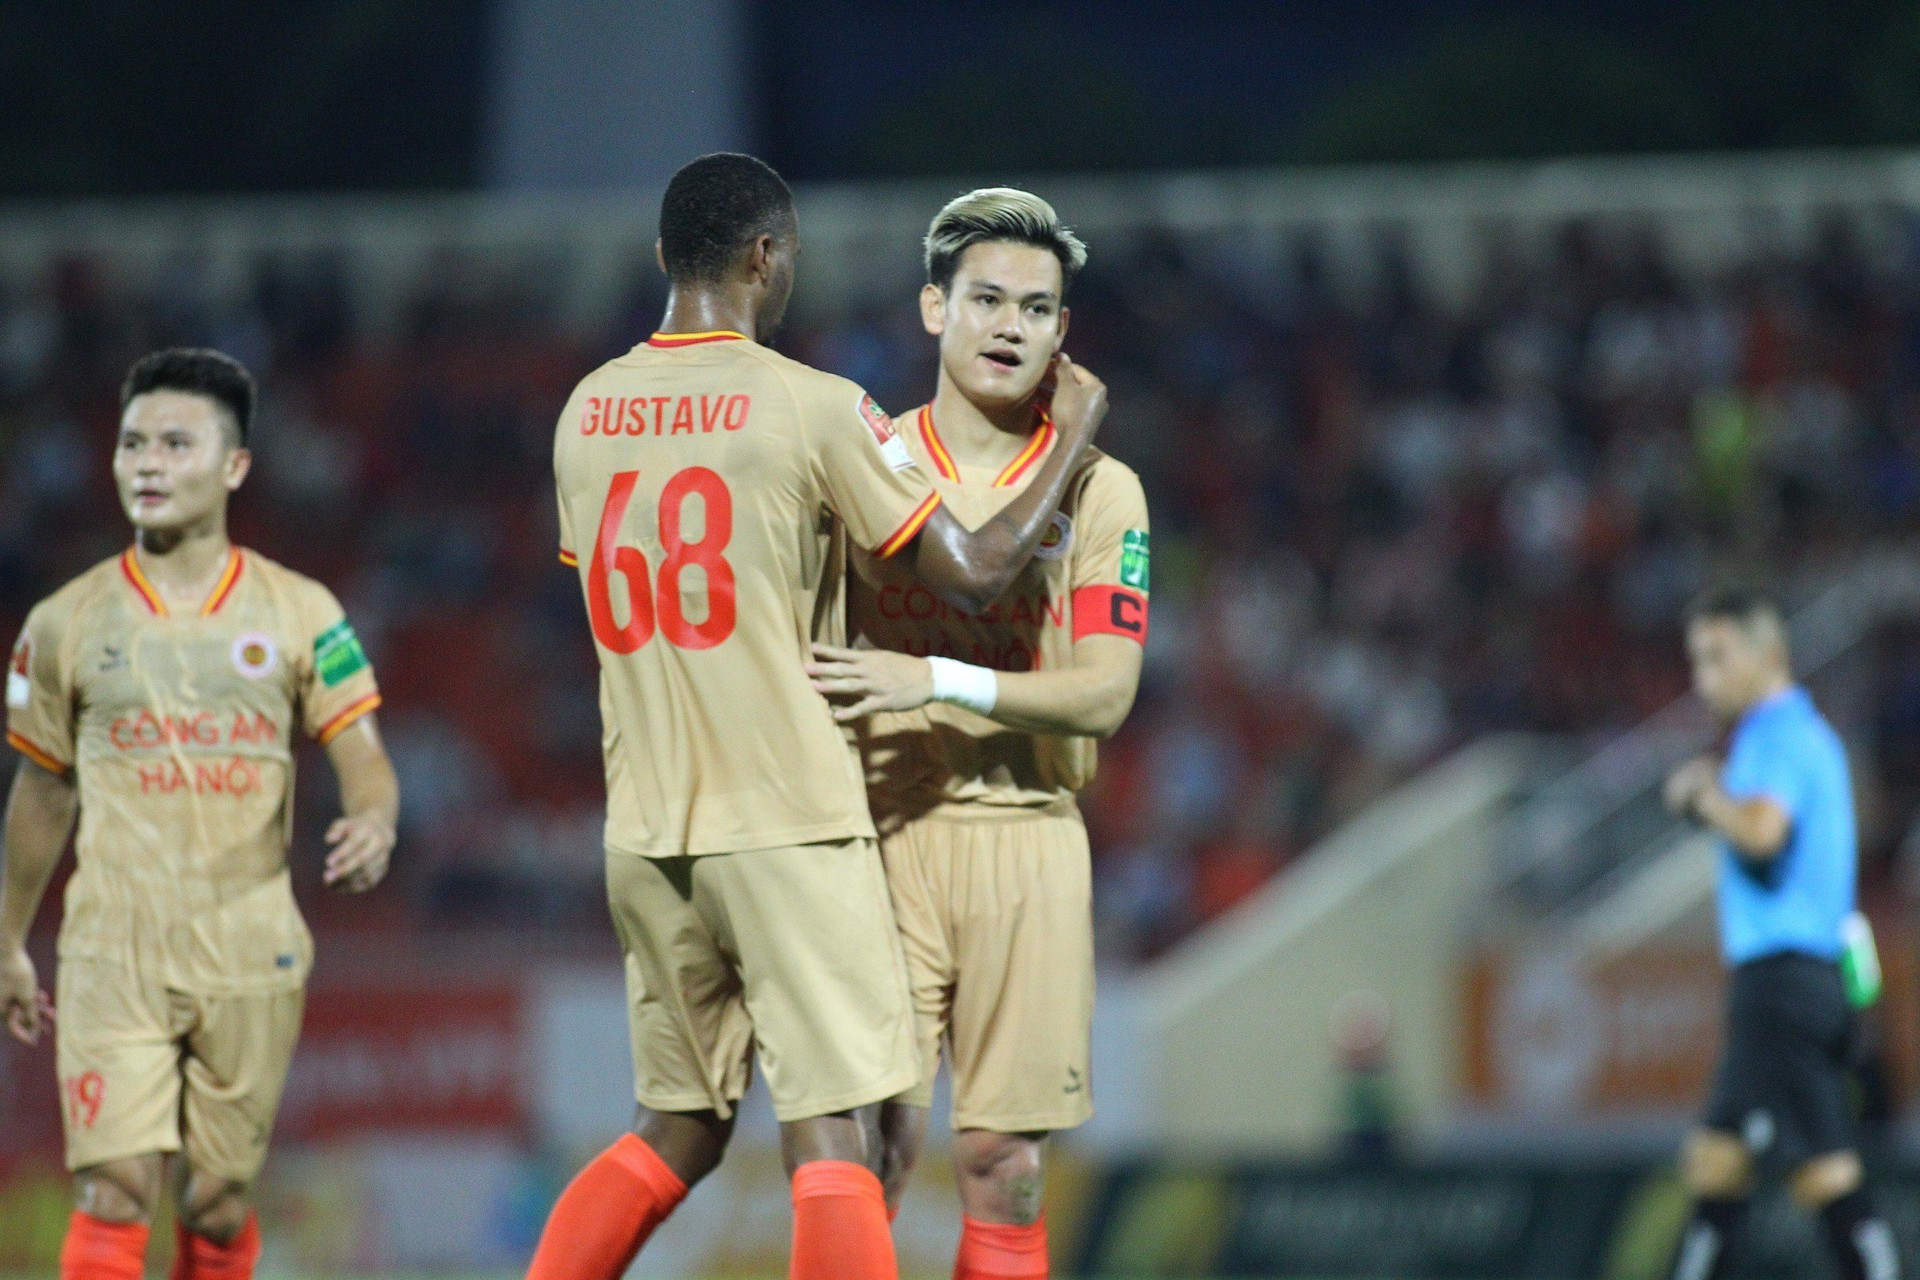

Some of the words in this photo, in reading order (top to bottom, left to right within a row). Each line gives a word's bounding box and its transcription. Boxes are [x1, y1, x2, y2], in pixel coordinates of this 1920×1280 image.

[580, 394, 750, 436] GUSTAVO
[587, 465, 738, 656] 68
[1110, 592, 1142, 633] C
[229, 711, 278, 746] AN
[66, 1071, 106, 1130] 19
